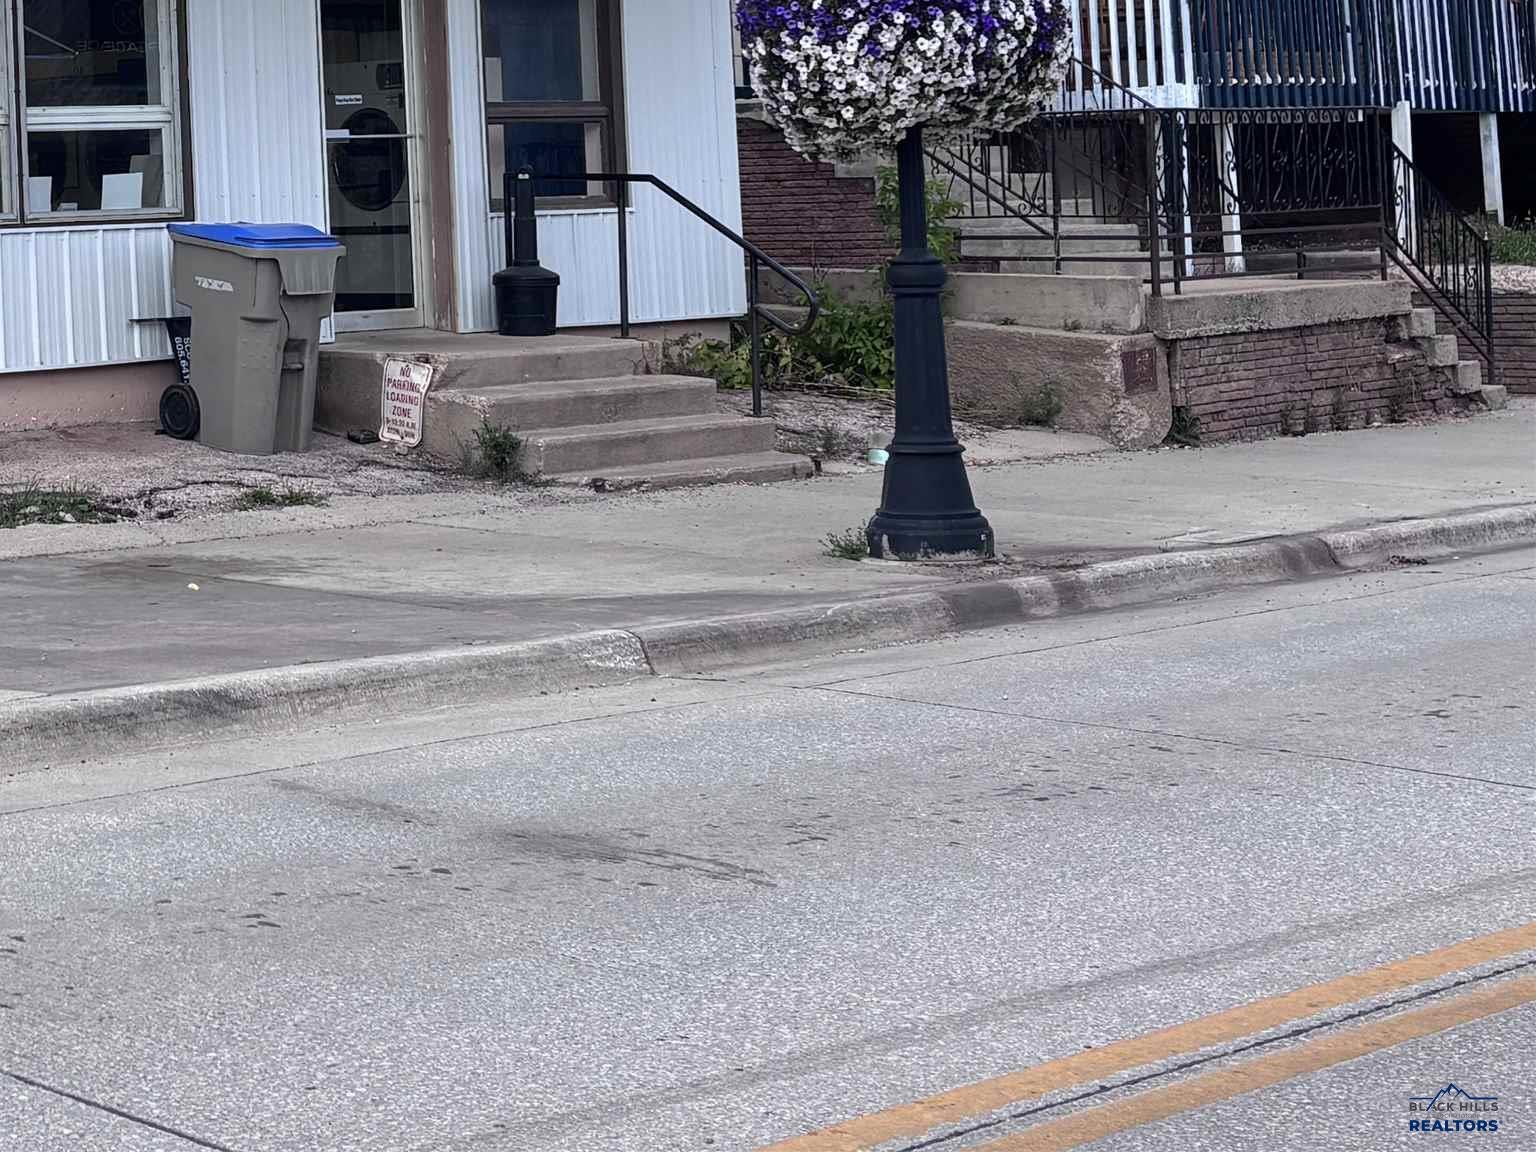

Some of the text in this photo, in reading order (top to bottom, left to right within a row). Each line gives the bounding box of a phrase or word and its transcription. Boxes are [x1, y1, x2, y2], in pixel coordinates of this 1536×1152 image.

[399, 366, 412, 378] NO
[386, 377, 421, 393] PARKING
[385, 391, 419, 406] LOADING
[392, 405, 413, 418] ZONE
